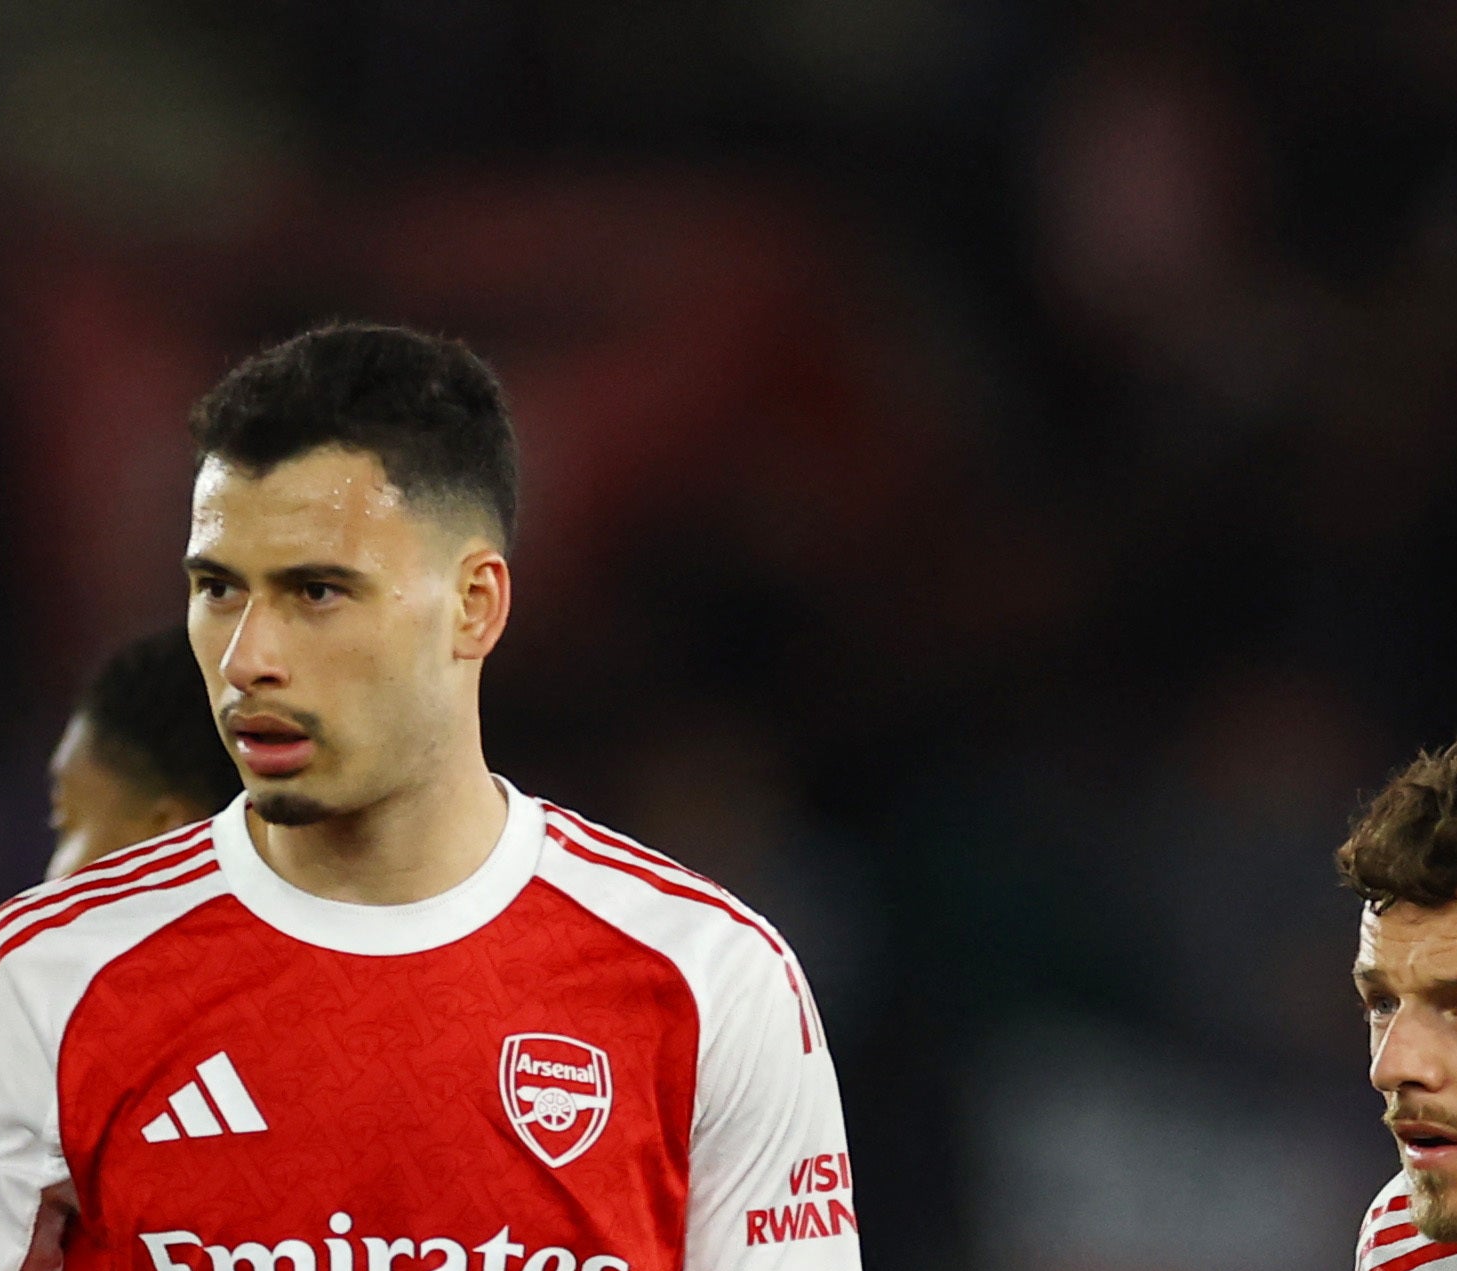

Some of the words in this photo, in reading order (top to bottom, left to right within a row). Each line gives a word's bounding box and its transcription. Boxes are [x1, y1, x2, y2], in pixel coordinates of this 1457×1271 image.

[516, 1053, 596, 1085] Arsenal
[789, 1152, 850, 1197] VISI
[746, 1198, 859, 1247] RWAN
